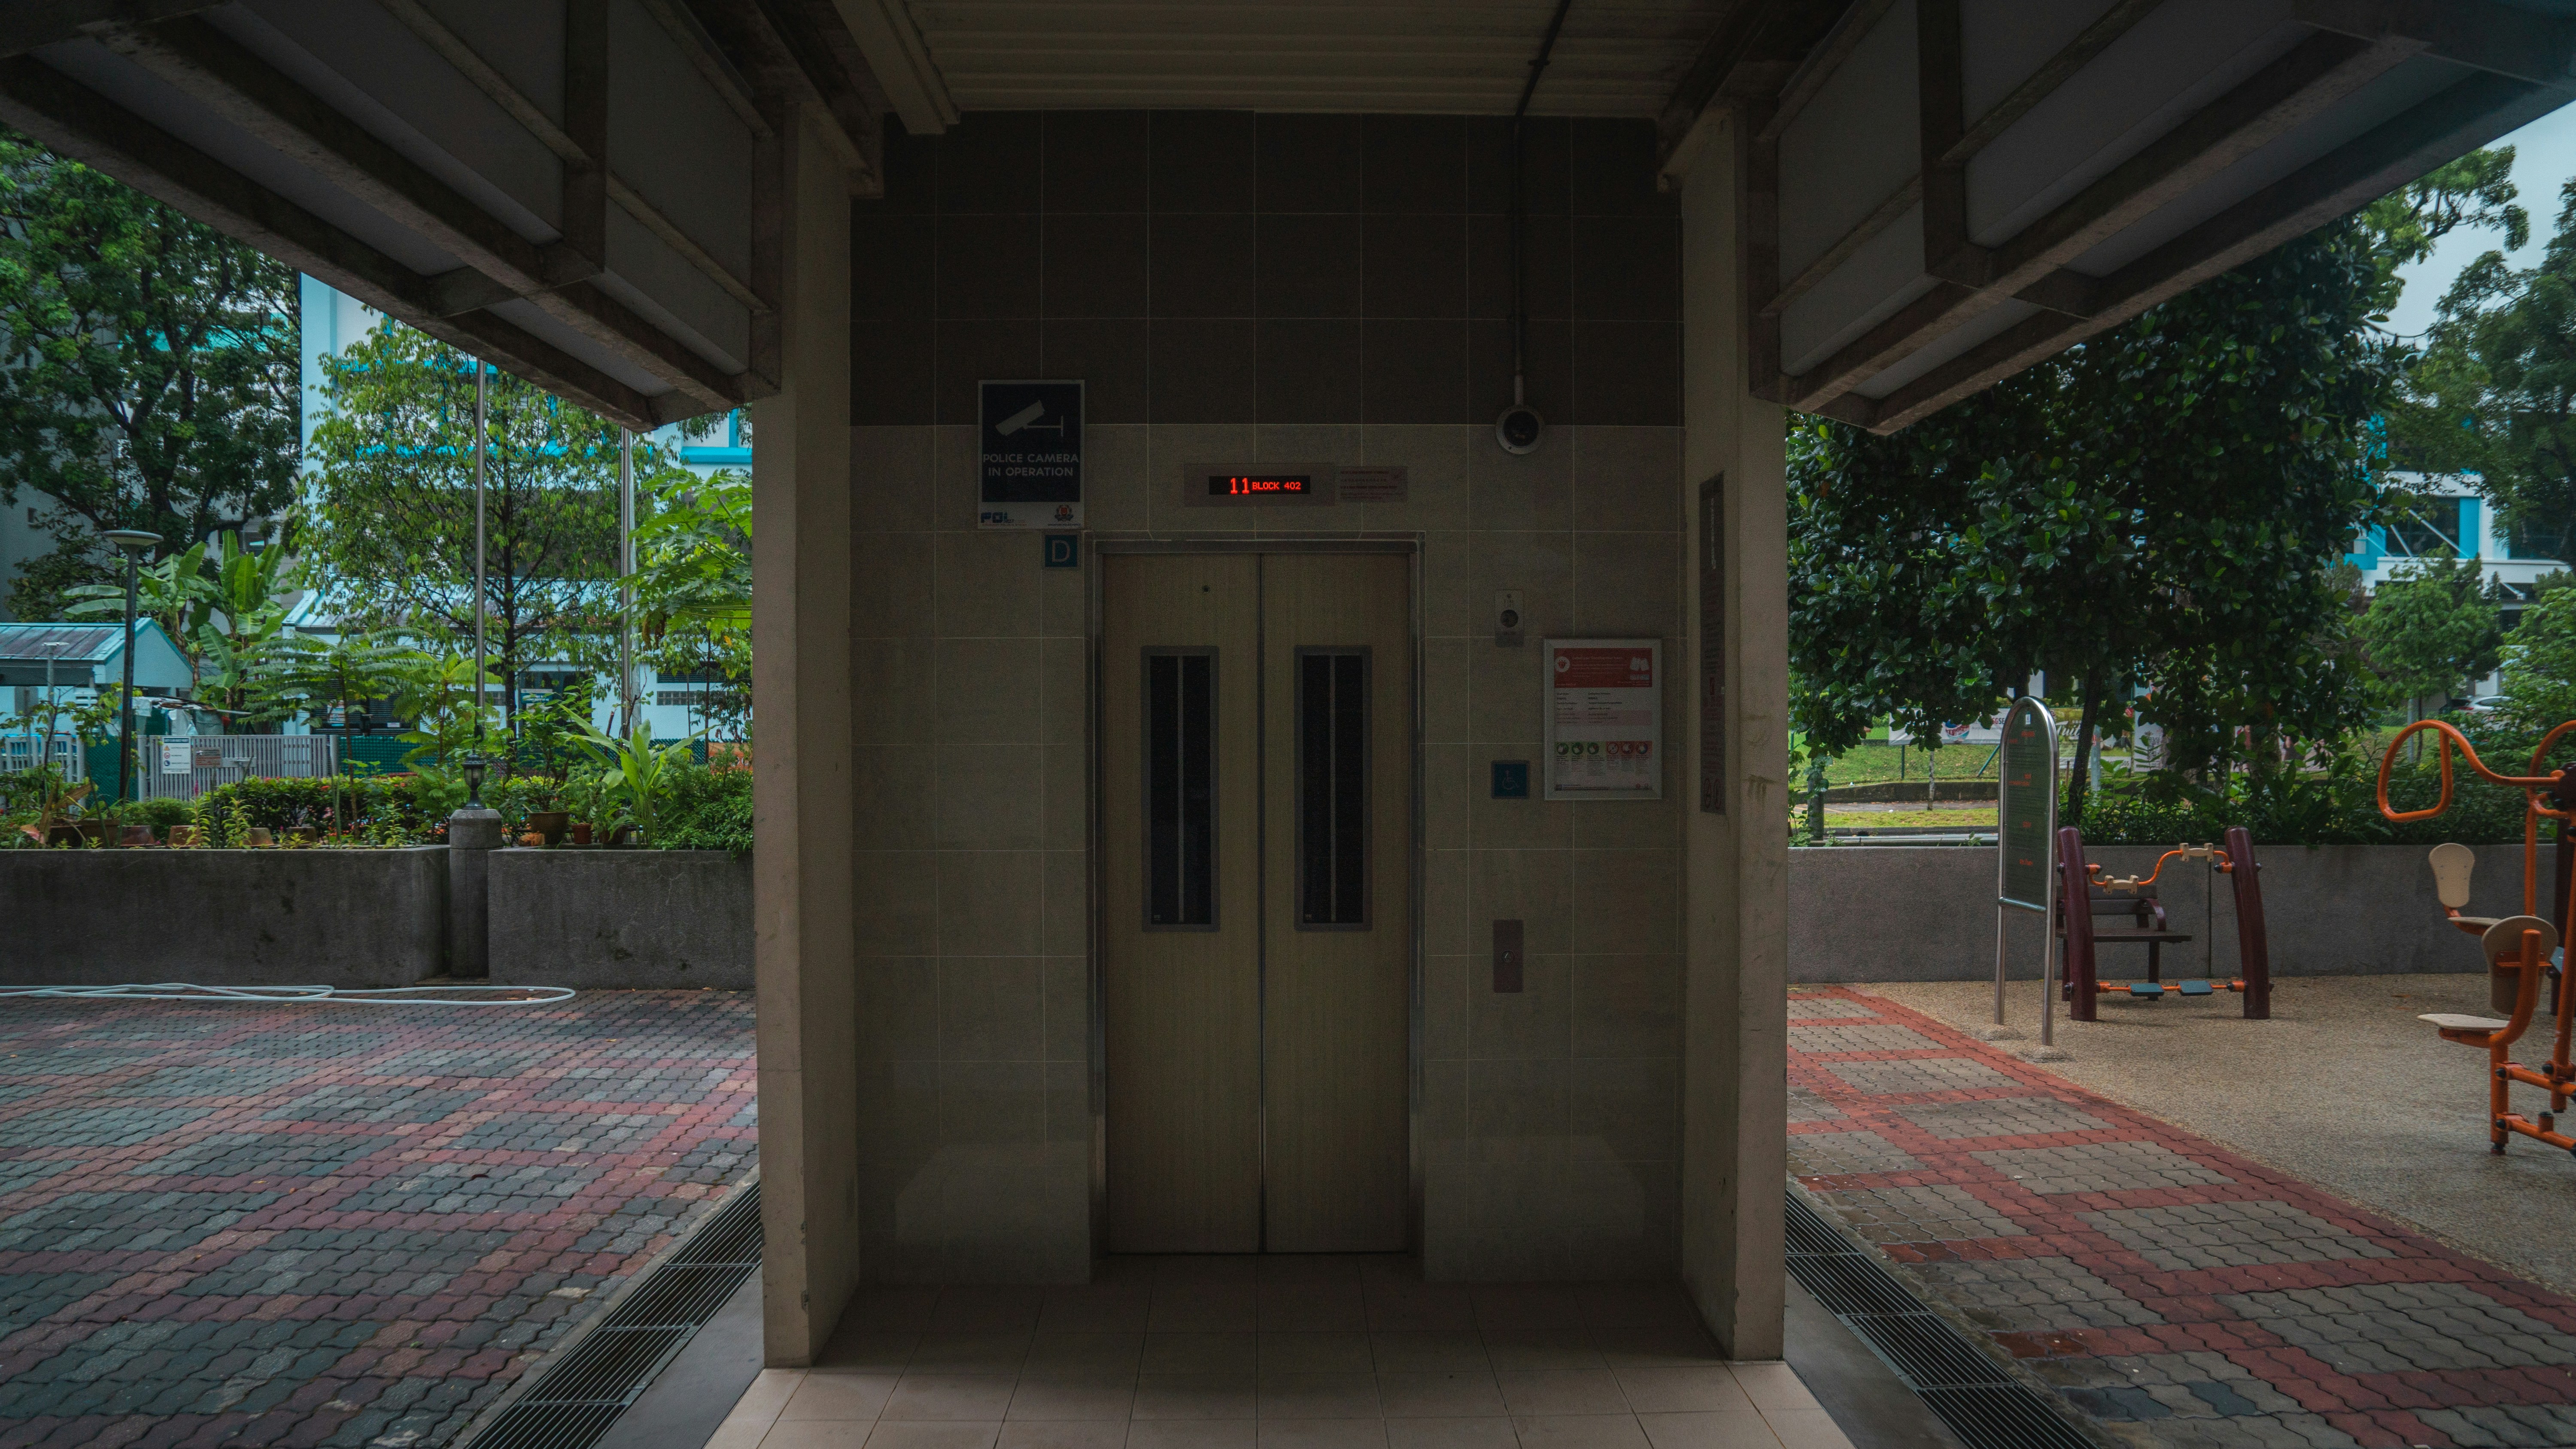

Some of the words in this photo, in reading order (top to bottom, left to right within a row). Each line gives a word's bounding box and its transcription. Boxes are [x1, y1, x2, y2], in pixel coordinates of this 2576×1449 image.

[983, 453, 1023, 462] POLICE
[1027, 453, 1079, 462] CAMERA
[988, 467, 1001, 476] IN
[1005, 467, 1073, 476] OPERATION
[1230, 477, 1250, 495] 11
[1251, 481, 1280, 491] BLOCK
[1283, 481, 1302, 491] 402
[1052, 540, 1070, 562] D
